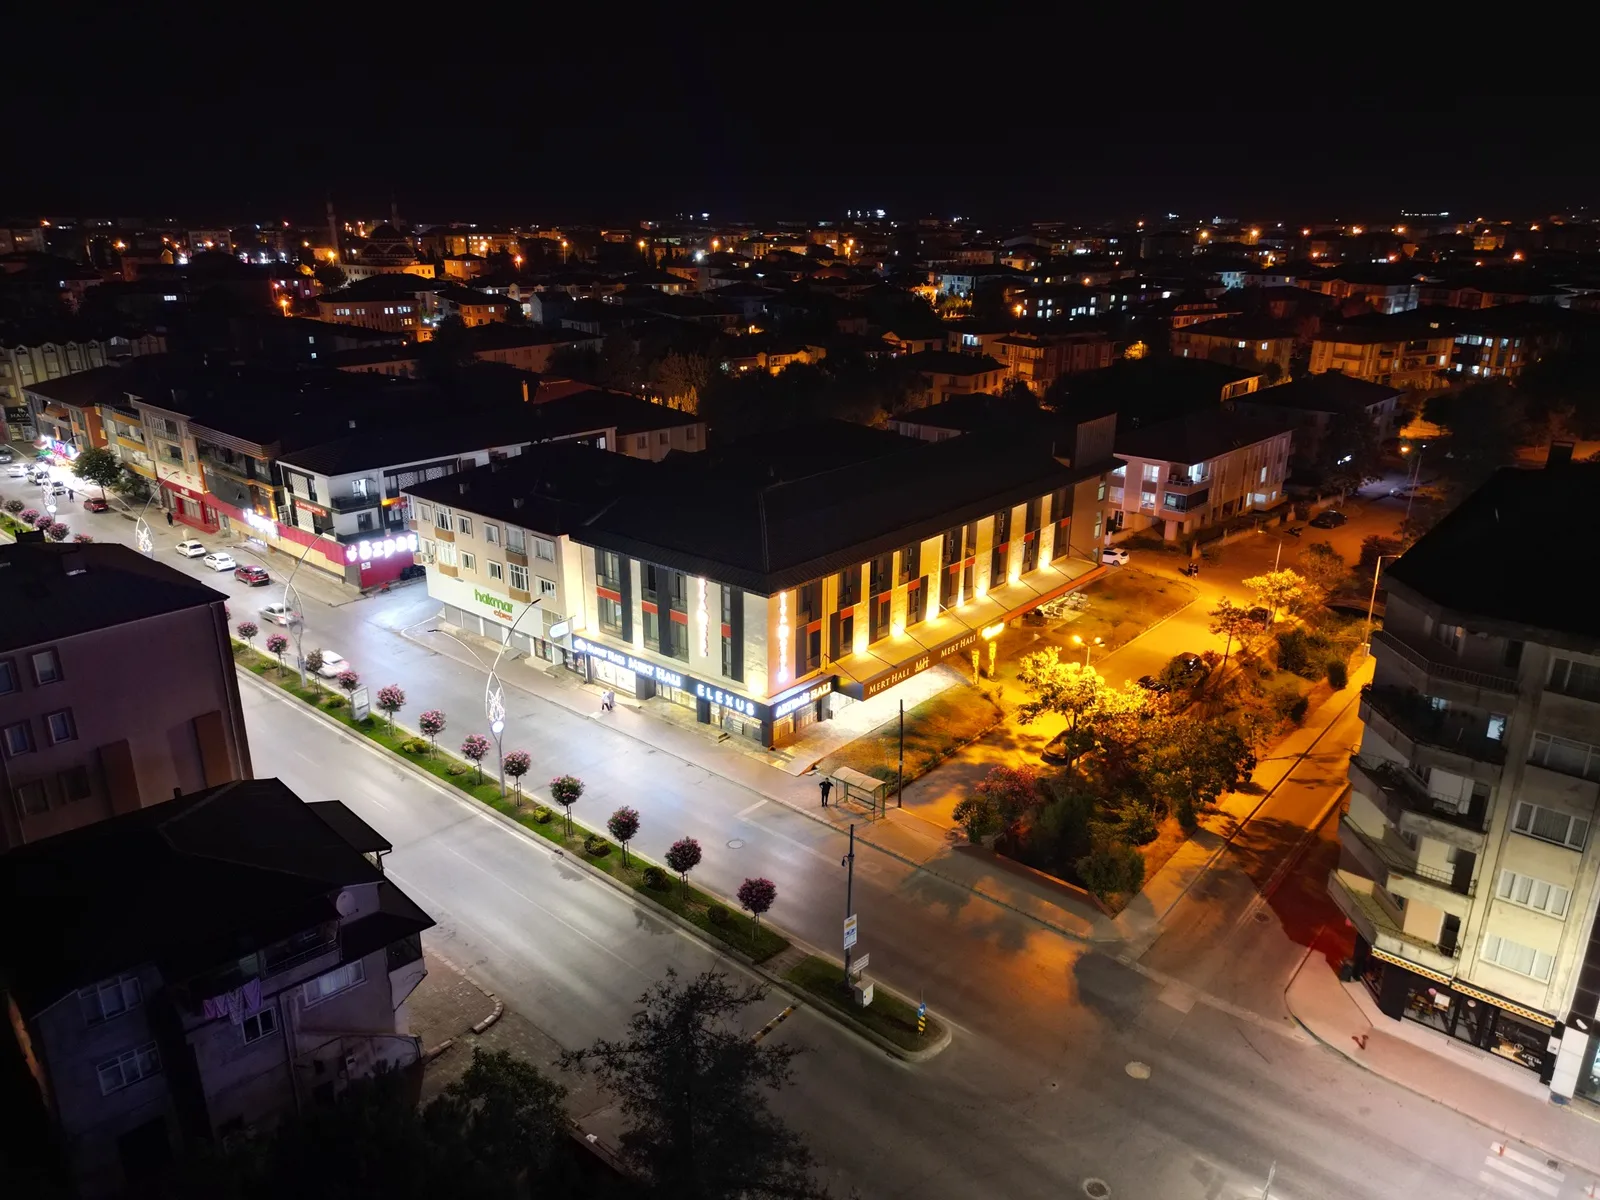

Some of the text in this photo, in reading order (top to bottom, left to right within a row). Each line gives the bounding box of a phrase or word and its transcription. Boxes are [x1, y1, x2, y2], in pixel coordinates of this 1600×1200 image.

[474, 588, 514, 613] hakmar
[940, 642, 959, 658] MERT
[868, 678, 891, 695] MERT
[696, 683, 755, 716] ELEXUS
